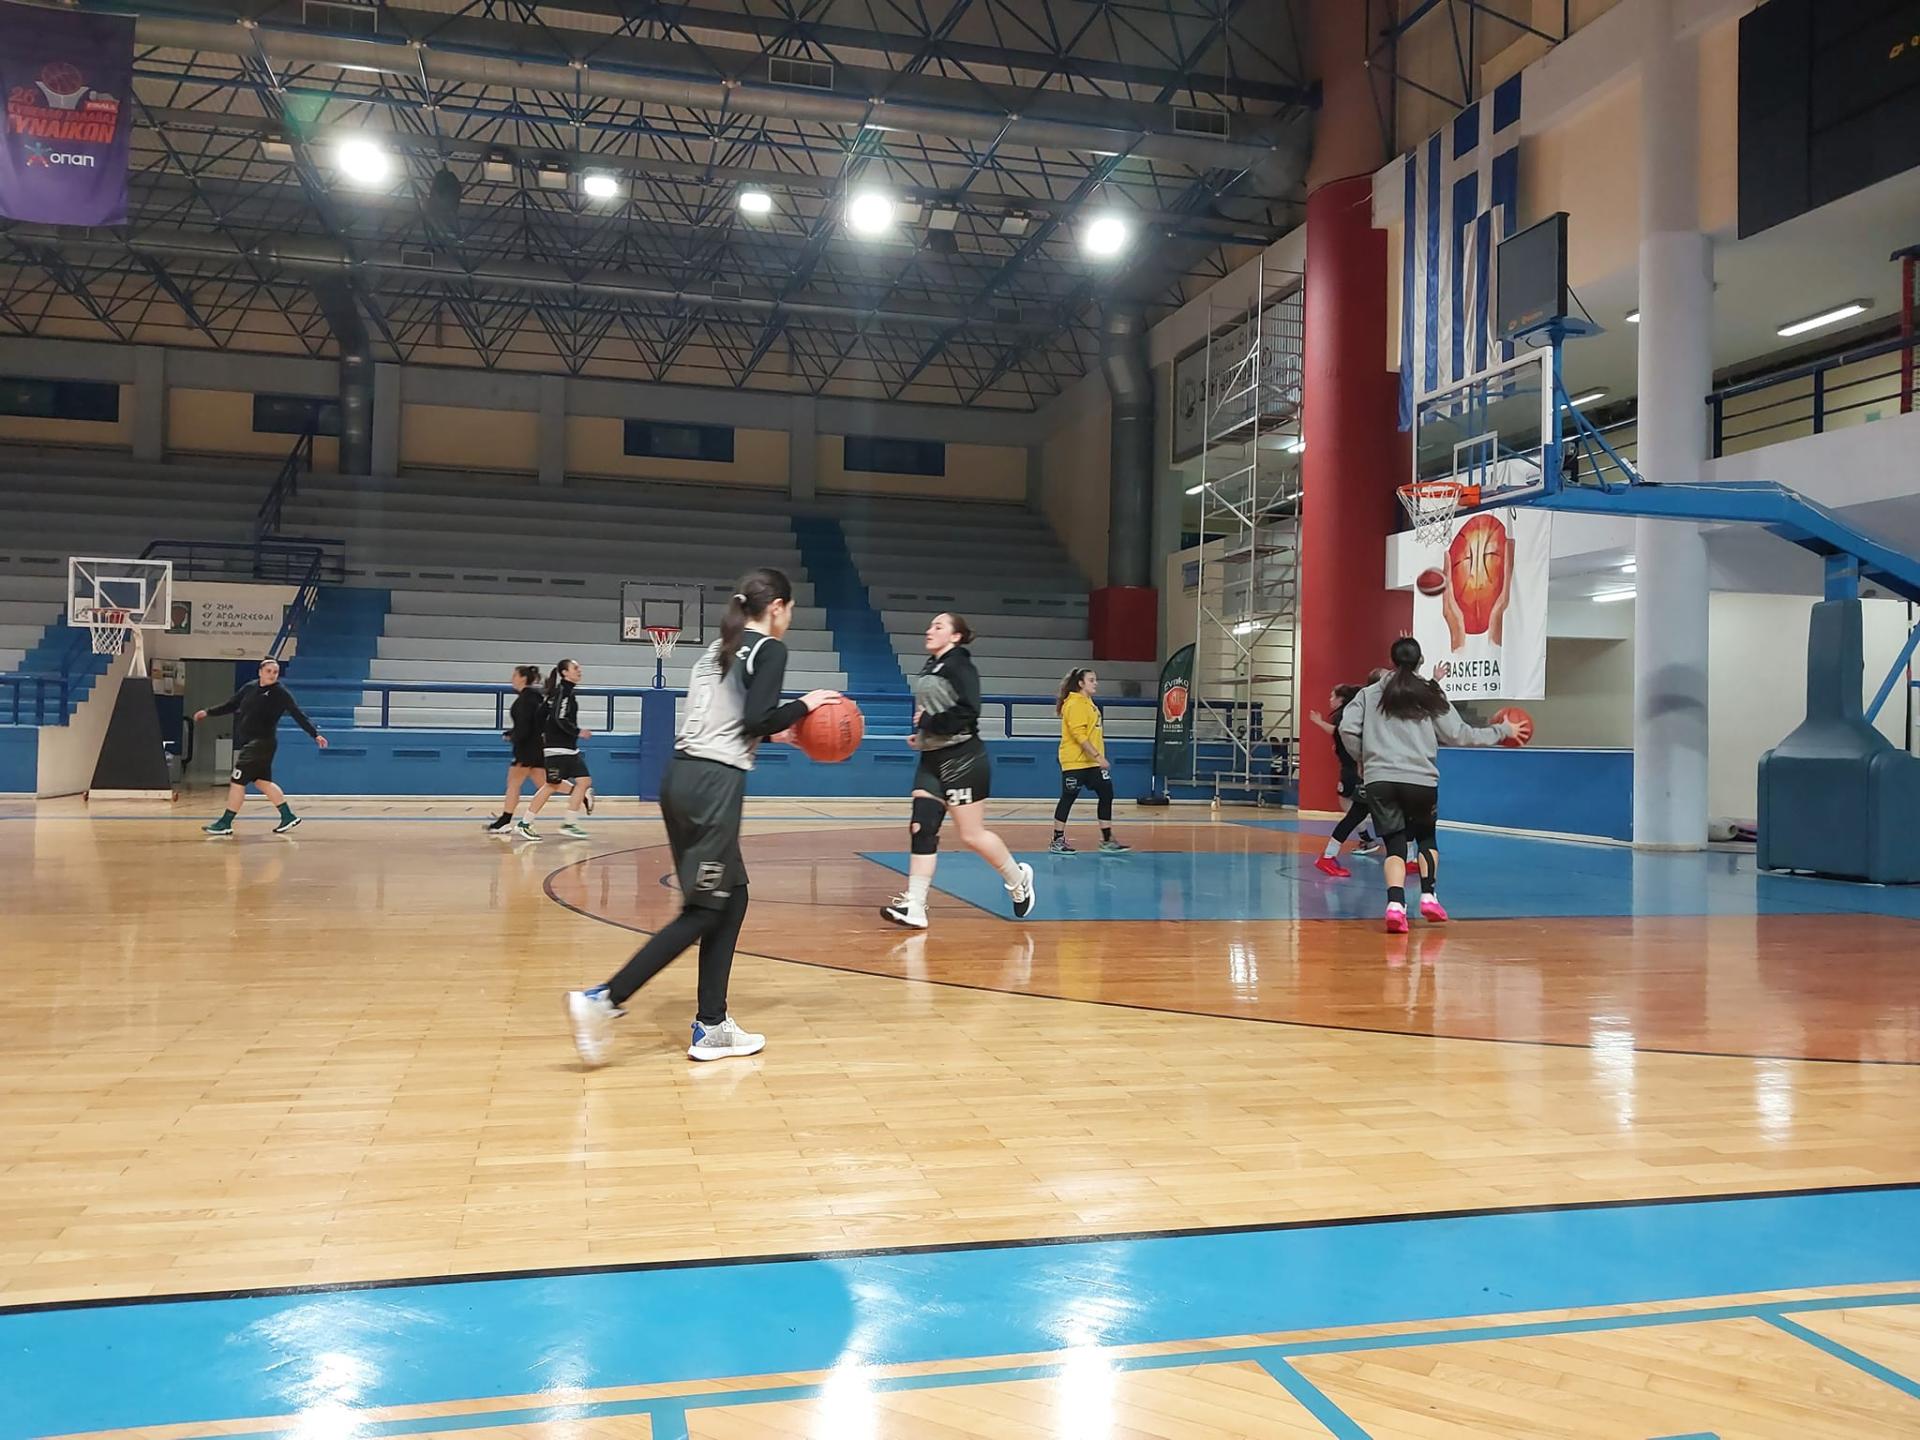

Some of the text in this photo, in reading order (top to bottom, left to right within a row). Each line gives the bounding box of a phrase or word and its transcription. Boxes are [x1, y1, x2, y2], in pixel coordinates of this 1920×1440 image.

[1445, 682, 1501, 692] SINCE 19
[945, 787, 972, 806] 34
